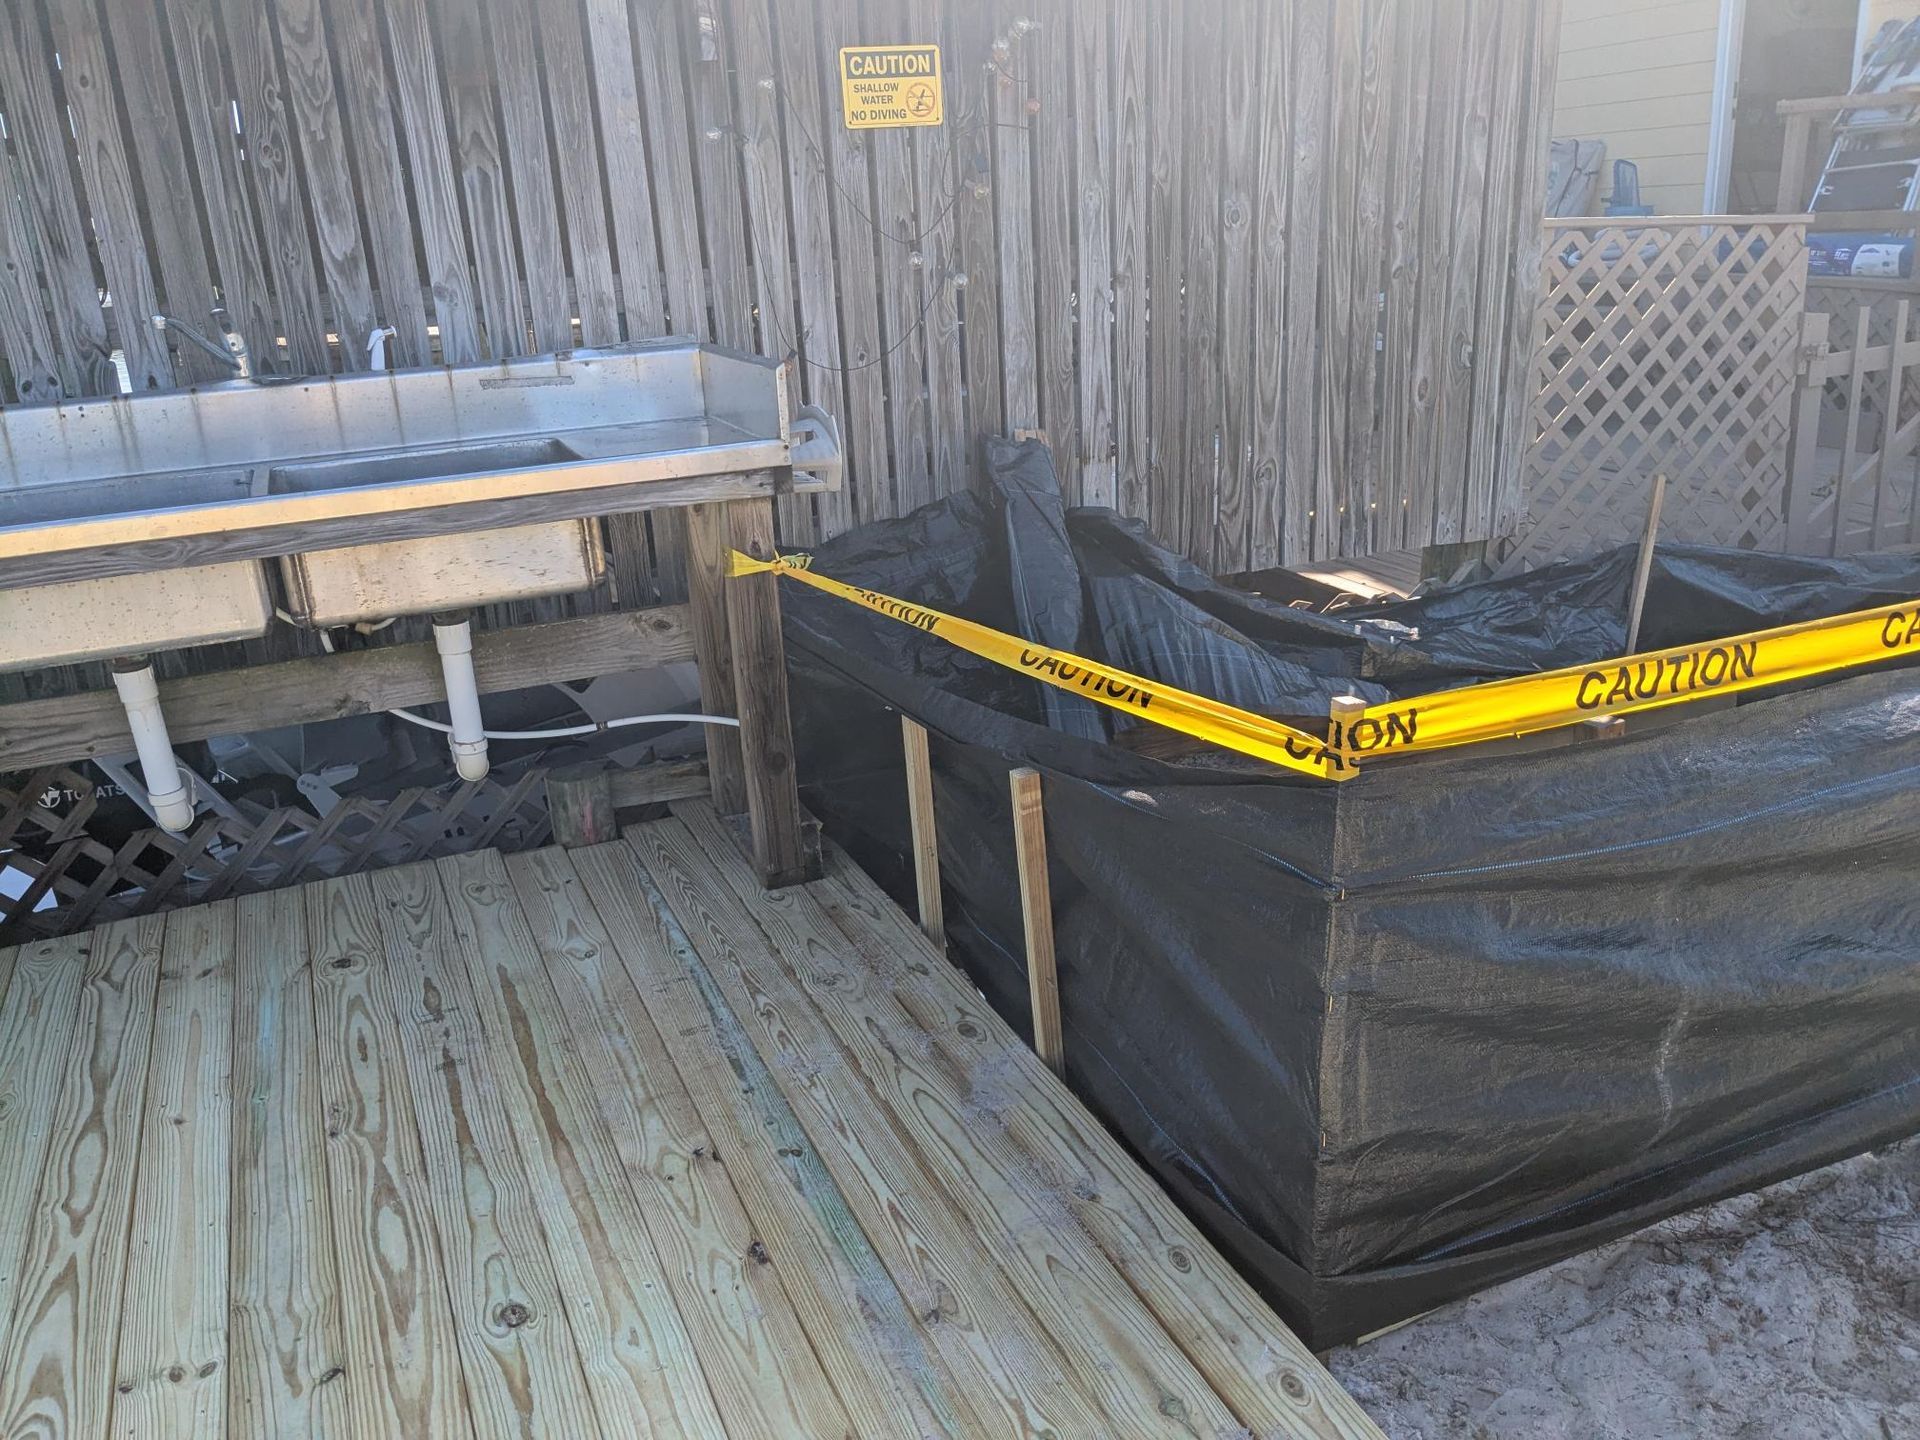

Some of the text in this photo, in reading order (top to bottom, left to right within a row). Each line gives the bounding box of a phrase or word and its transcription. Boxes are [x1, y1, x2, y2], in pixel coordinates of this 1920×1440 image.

[849, 54, 930, 76] CAUTION
[853, 82, 899, 93] SHALLOW
[861, 95, 894, 105] WATER
[851, 109, 907, 121] NO DIVING
[1576, 641, 1757, 710] CAUTION
